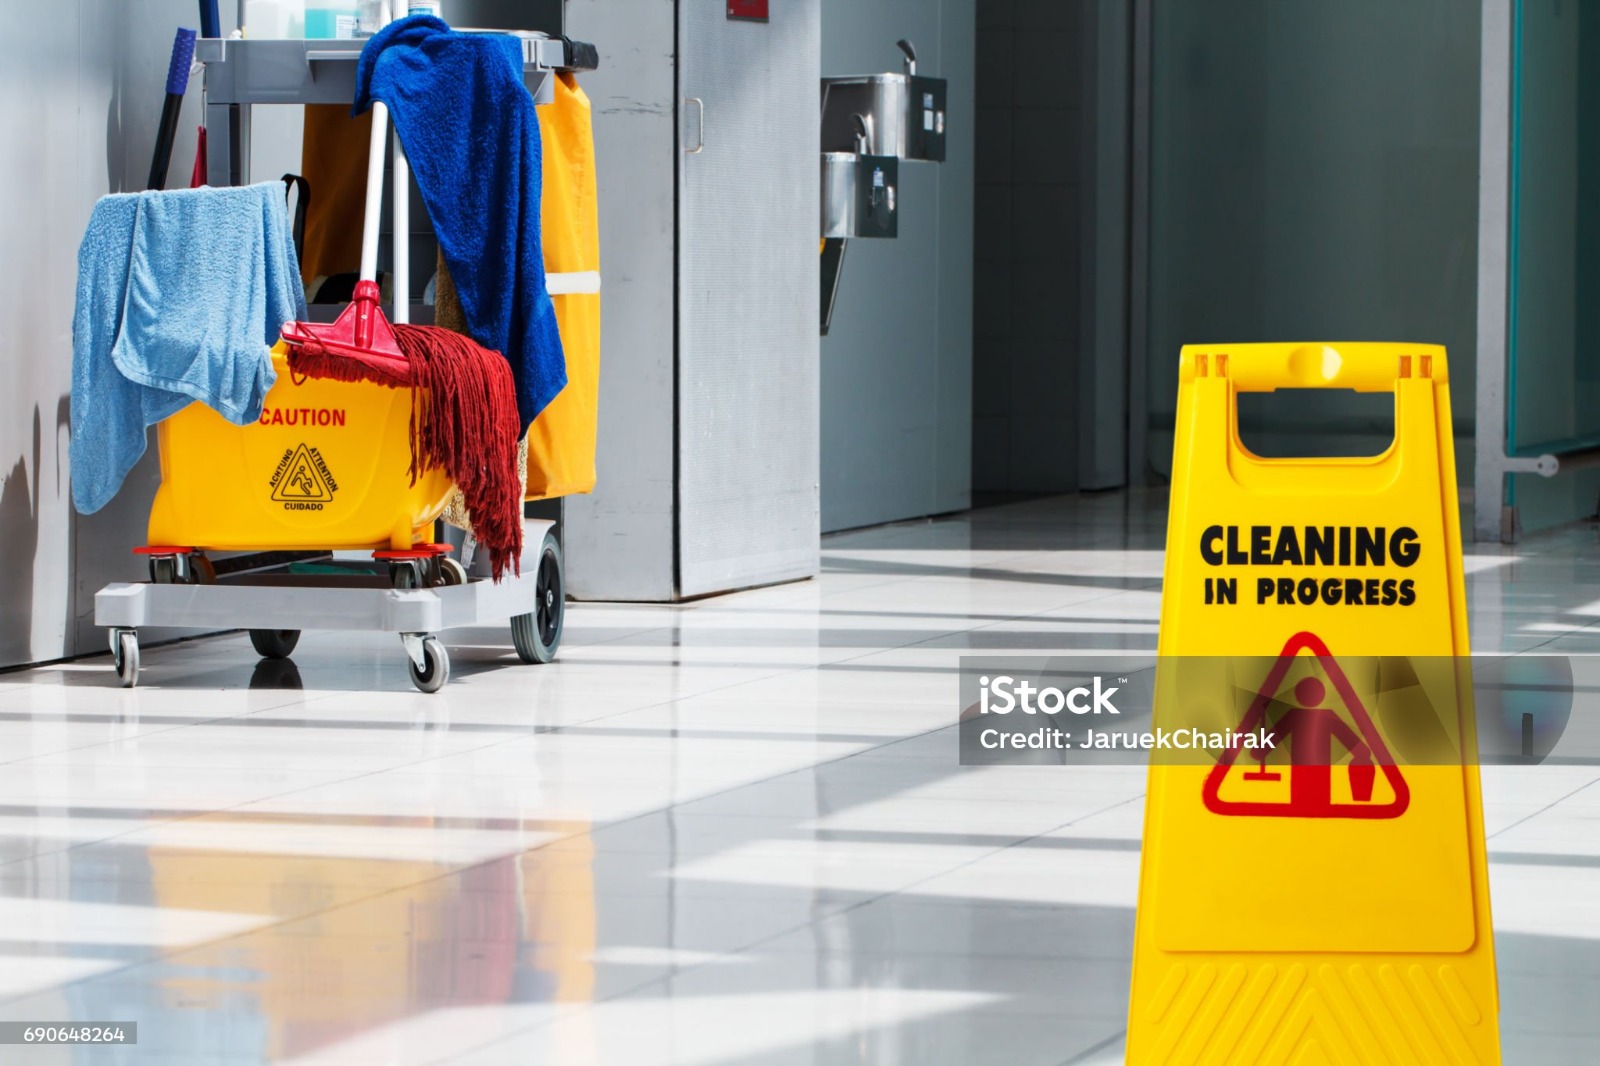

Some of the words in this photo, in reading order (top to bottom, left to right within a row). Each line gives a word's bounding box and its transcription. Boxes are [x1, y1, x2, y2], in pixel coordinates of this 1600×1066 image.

[259, 408, 345, 426] CAUTION
[269, 448, 293, 488] ACHTUNG
[309, 447, 338, 492] ATTENTION
[284, 502, 323, 511] CUIDADO
[1200, 525, 1421, 568] CLEANING
[1204, 578, 1237, 605] IN
[1257, 577, 1416, 606] PROGRESS
